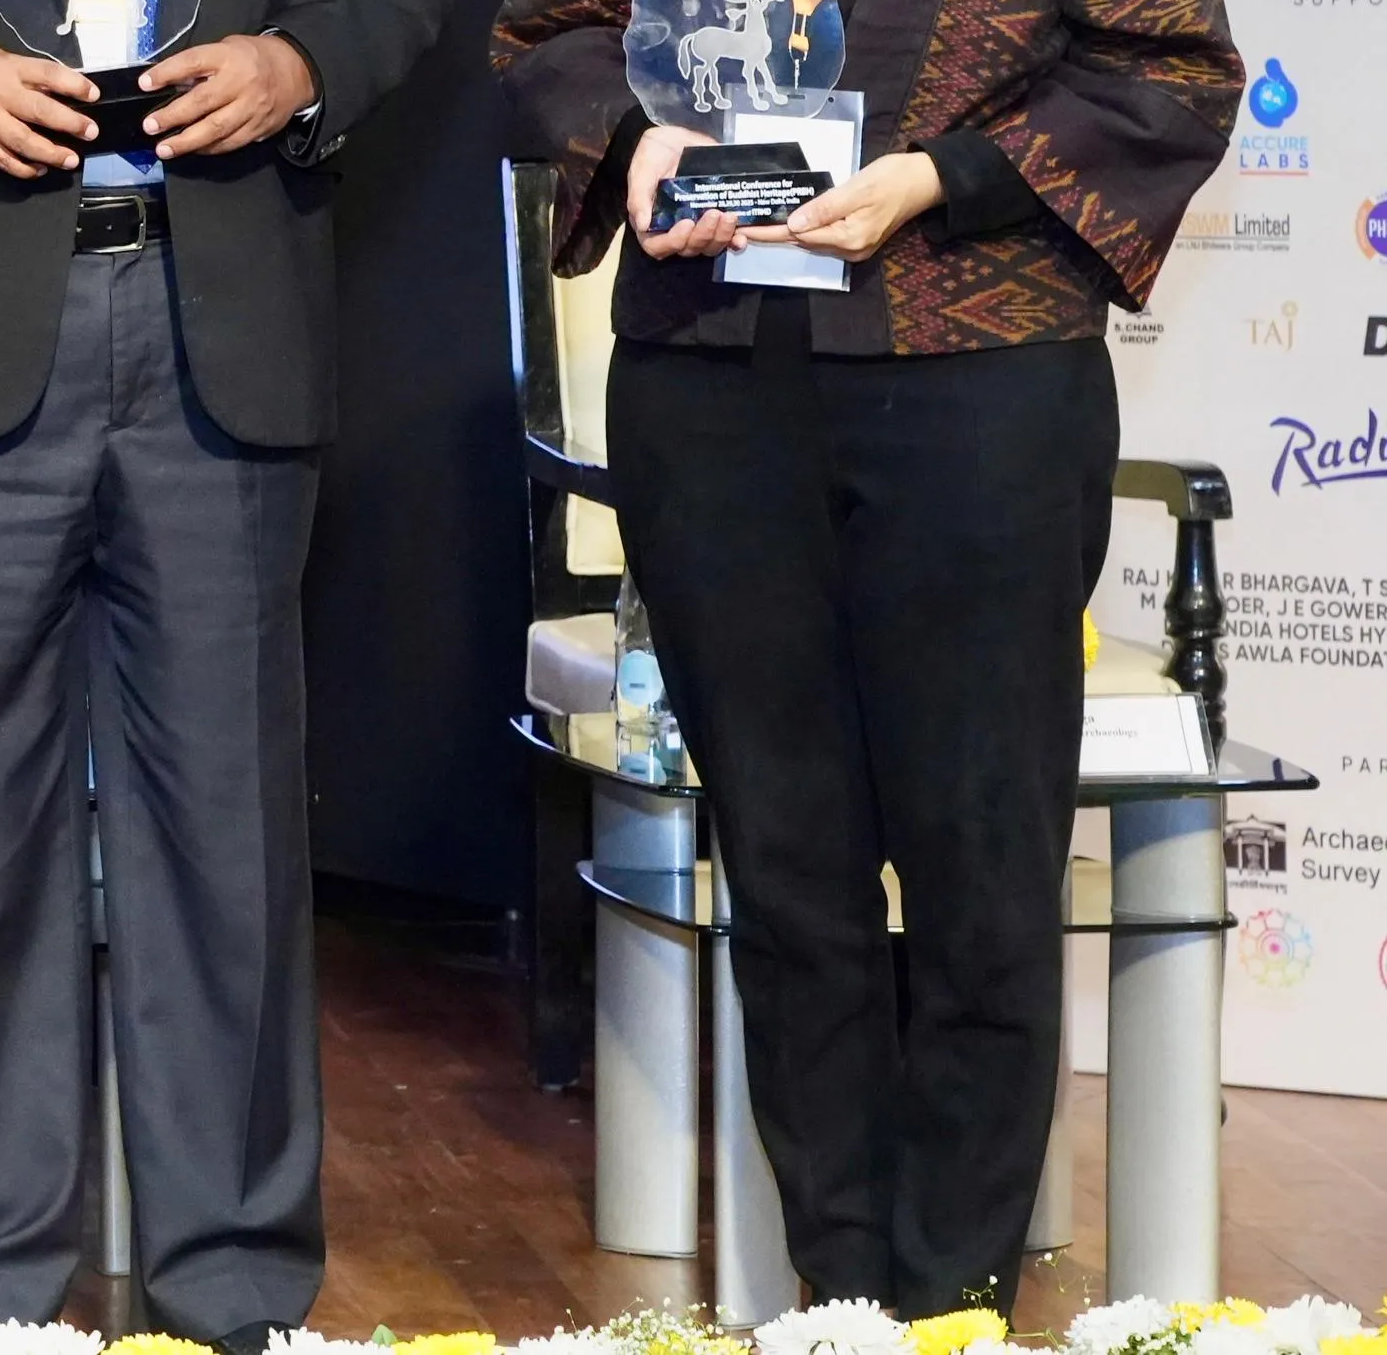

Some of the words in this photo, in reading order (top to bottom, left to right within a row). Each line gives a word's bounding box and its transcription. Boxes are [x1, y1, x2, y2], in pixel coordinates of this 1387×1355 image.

[1240, 136, 1309, 152] ACCURE
[1239, 153, 1309, 169] LABS
[674, 192, 719, 202] Preservation
[727, 189, 760, 199] Buddhist
[695, 181, 741, 192] International
[741, 180, 782, 189] Conference
[782, 179, 793, 187] for
[1181, 213, 1228, 235] SWM
[1234, 213, 1290, 235] Limited
[1125, 323, 1164, 333] CHAND
[1245, 318, 1296, 352] TAJ
[1120, 334, 1159, 344] GROUP
[1123, 568, 1160, 587] RAJ
[1241, 573, 1356, 598] BHARGAVA,
[1362, 579, 1373, 596] T
[1141, 593, 1156, 610] M
[1277, 600, 1288, 616] J
[1295, 601, 1304, 616] E
[1226, 620, 1273, 639] NDIA
[1279, 623, 1353, 643] HOTELS
[1235, 646, 1294, 664] AWLA
[1302, 826, 1387, 852] Archae
[1301, 859, 1381, 889] Survey
